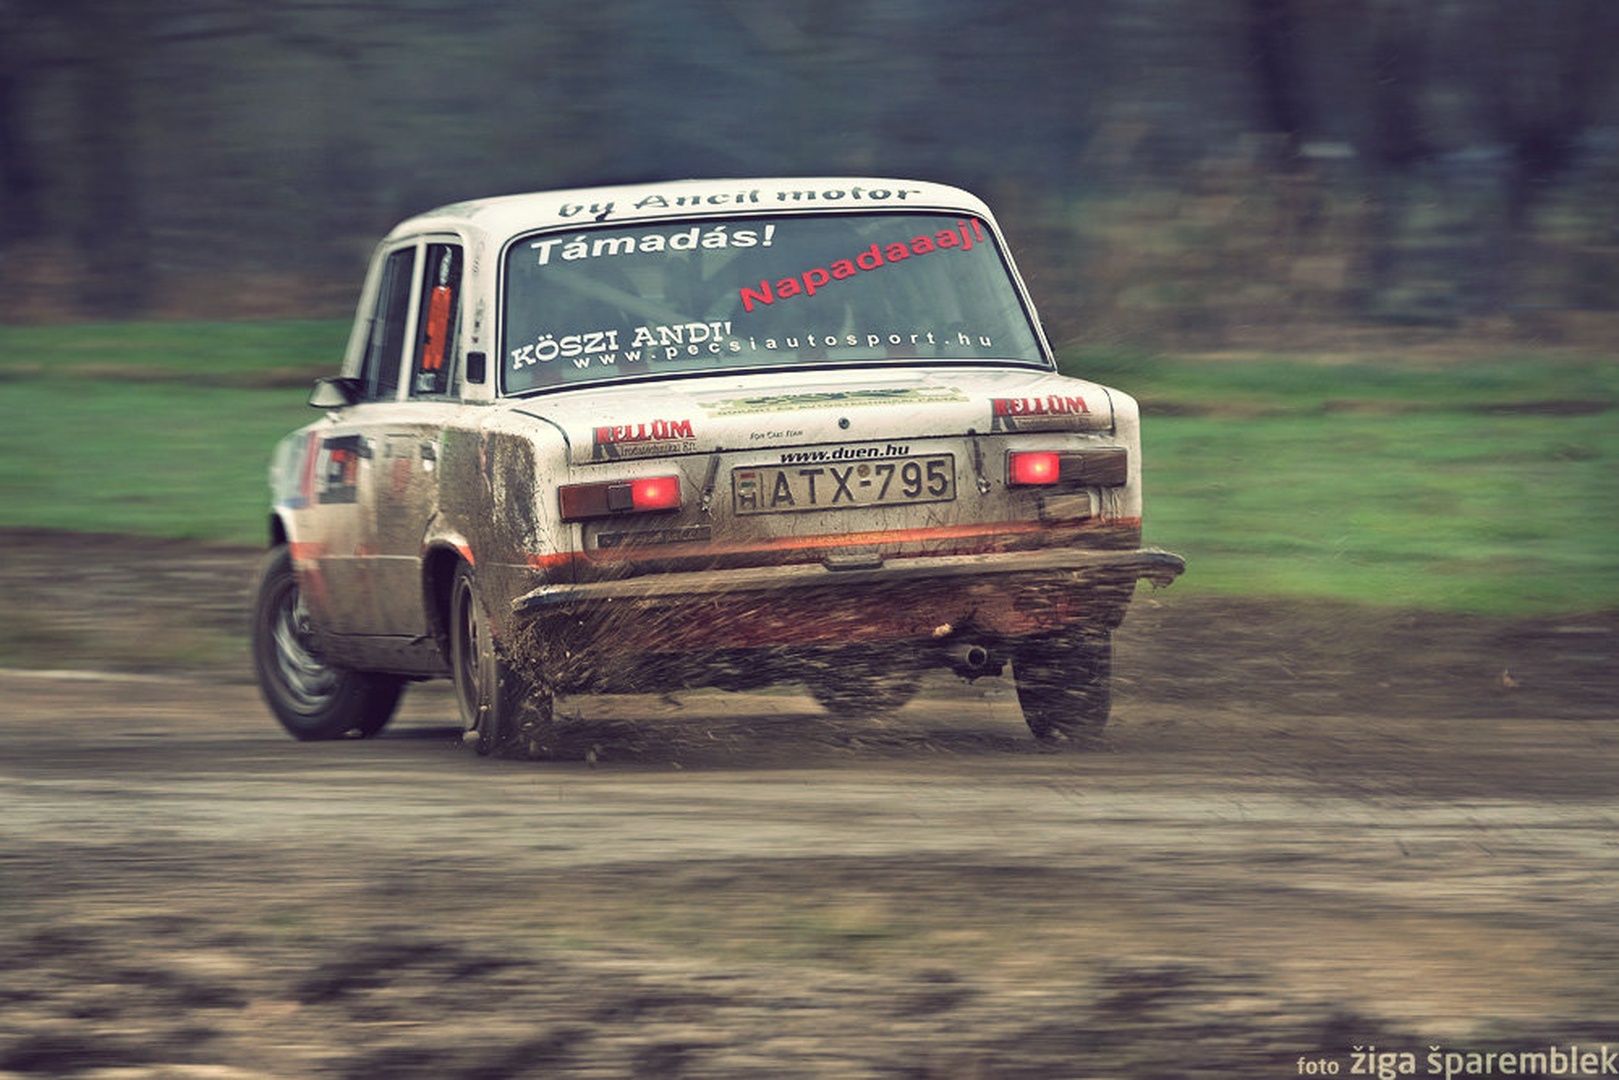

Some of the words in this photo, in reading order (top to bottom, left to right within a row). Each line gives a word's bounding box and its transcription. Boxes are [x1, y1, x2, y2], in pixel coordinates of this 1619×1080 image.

[776, 187, 921, 202] motor
[530, 225, 776, 265] Támadás!
[739, 217, 986, 312] Napadaaaj!
[511, 330, 619, 370] KÖSZI
[631, 321, 732, 348] ANDI!
[573, 332, 993, 369] www.pecsiautosport.hu
[592, 419, 695, 455] RELLÜM
[780, 445, 910, 463] www.duen.hu
[770, 460, 949, 507] ATX-795
